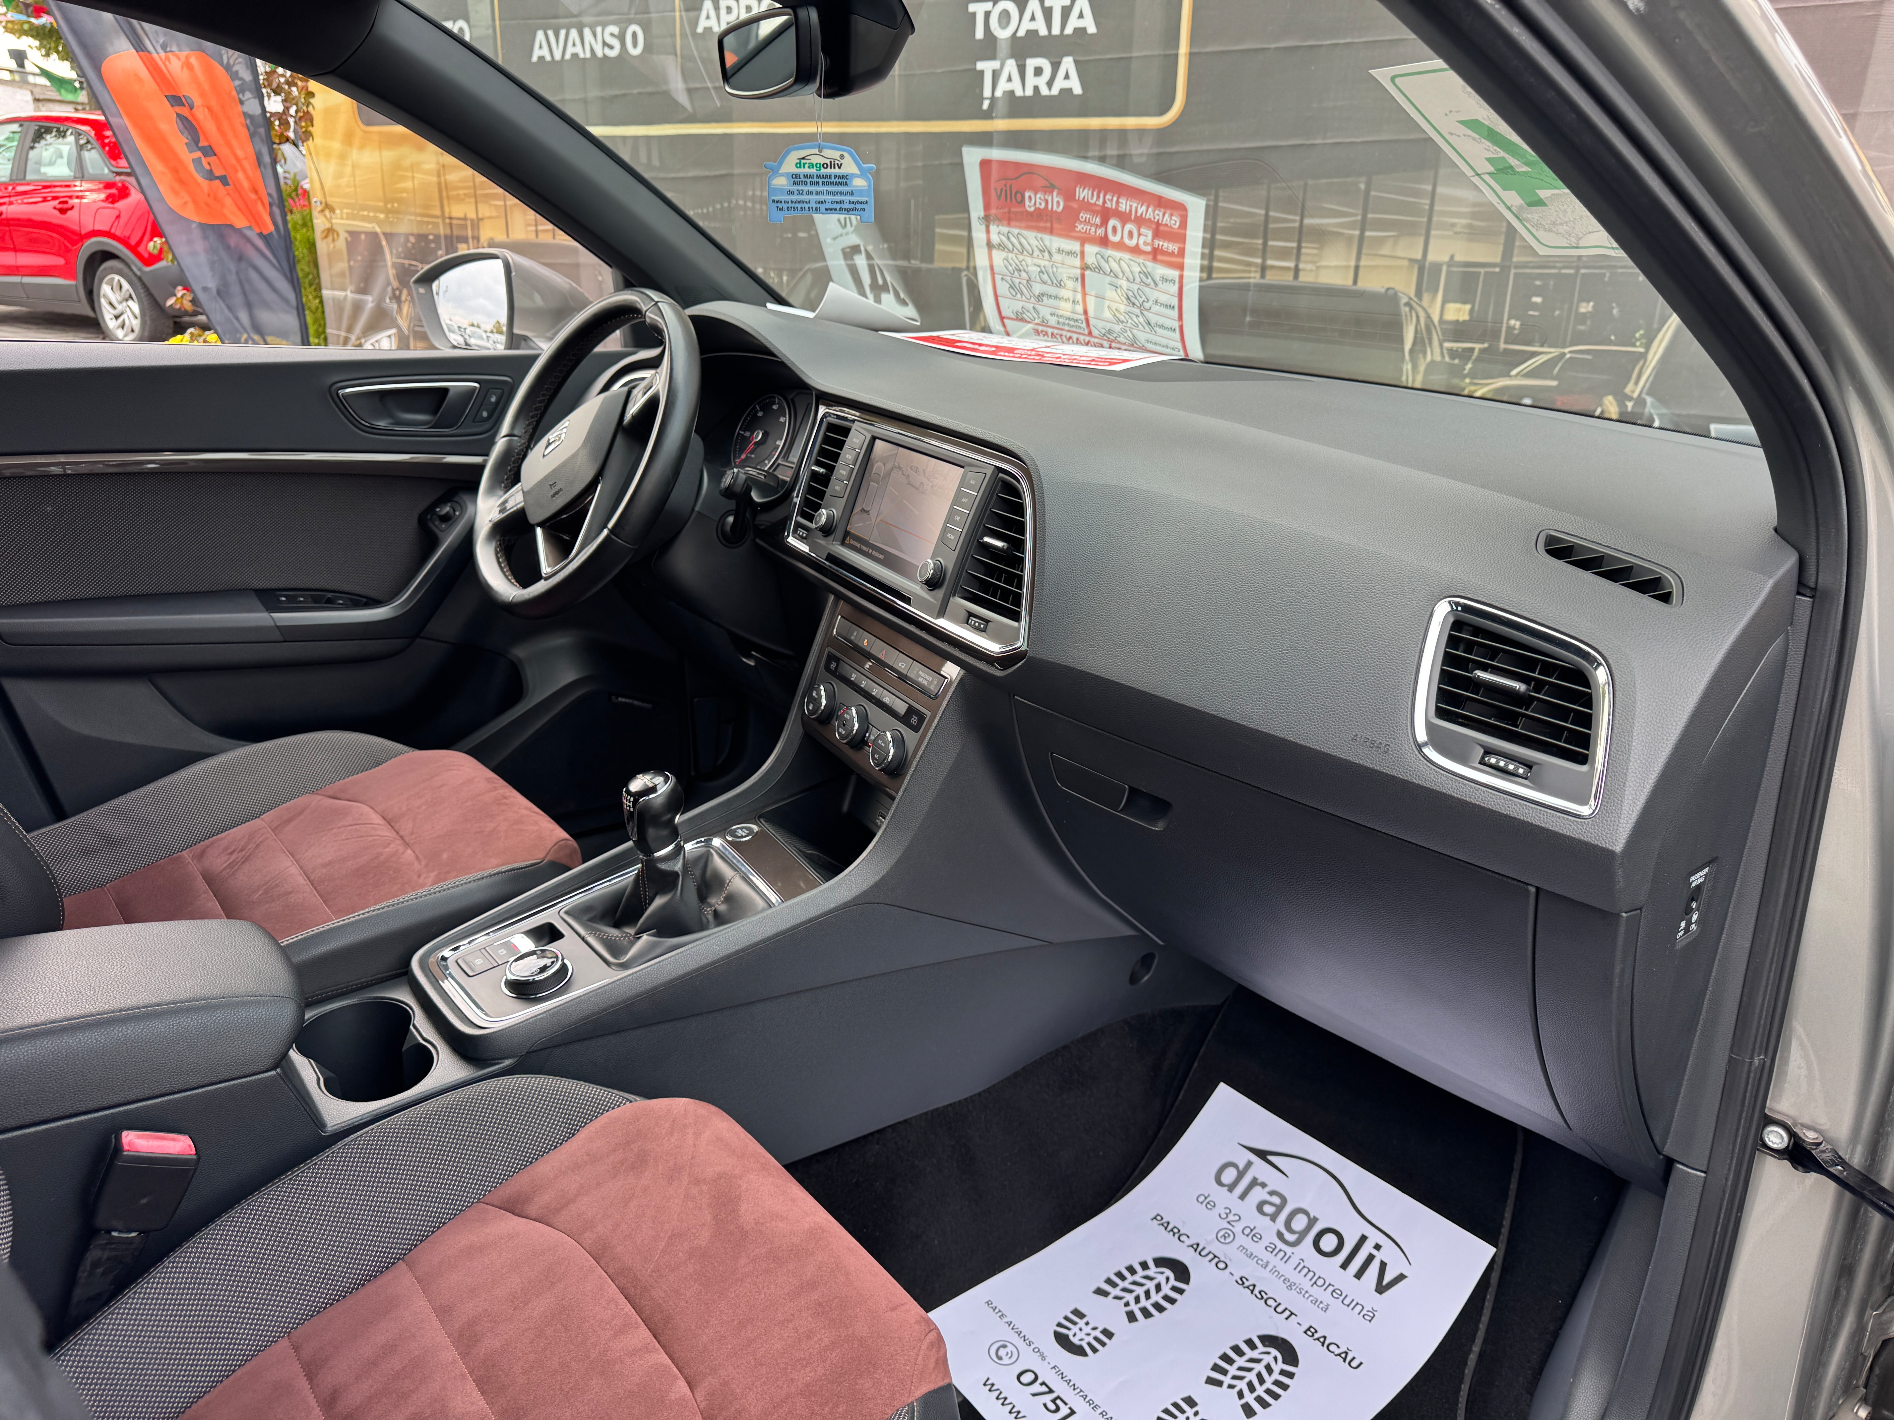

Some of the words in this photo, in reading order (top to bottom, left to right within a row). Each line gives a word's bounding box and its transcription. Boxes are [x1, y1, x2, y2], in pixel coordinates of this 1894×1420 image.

[531, 25, 621, 63] AVANS
[795, 160, 843, 172] dragoliv
[1196, 1192, 1217, 1211] de
[1218, 1206, 1242, 1228] 32
[1241, 1223, 1263, 1244] de
[1264, 1240, 1295, 1264] ani
[1293, 1258, 1379, 1324] împreună
[1214, 1159, 1408, 1296] dragoliv
[1236, 1243, 1271, 1270] marcă
[1268, 1265, 1331, 1314] înregistrată
[1150, 1213, 1190, 1244] PARC
[1187, 1242, 1229, 1272] AUTO
[1234, 1275, 1298, 1322] SASCUT
[1303, 1325, 1364, 1370] BACĂU
[984, 1299, 1008, 1321] RATE
[1004, 1320, 1034, 1348] AVANS
[1032, 1346, 1047, 1362] 0%
[1050, 1364, 1101, 1412] FINANȚARE
